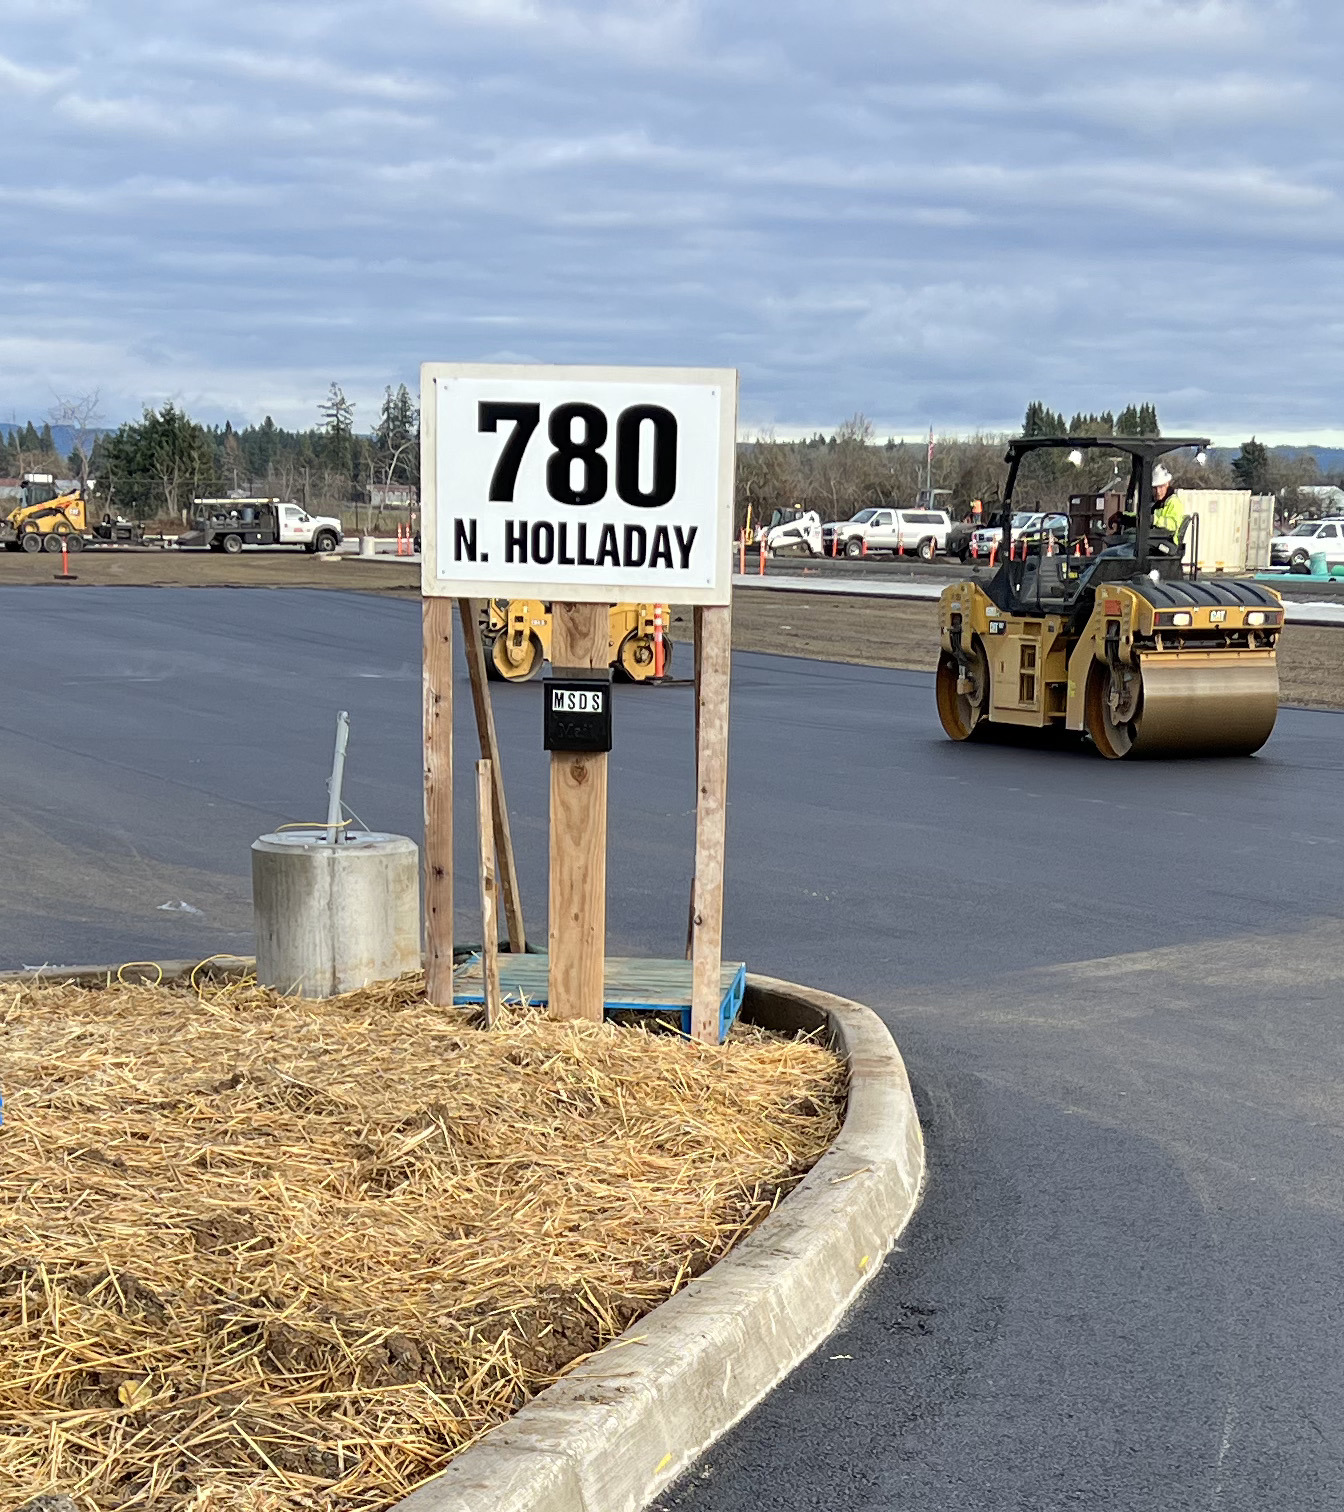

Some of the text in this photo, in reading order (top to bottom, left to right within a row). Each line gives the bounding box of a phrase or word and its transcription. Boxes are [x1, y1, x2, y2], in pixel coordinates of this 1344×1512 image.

[478, 401, 677, 507] 780
[454, 518, 698, 569] N. HOLLADAY
[554, 692, 600, 710] MSDS
